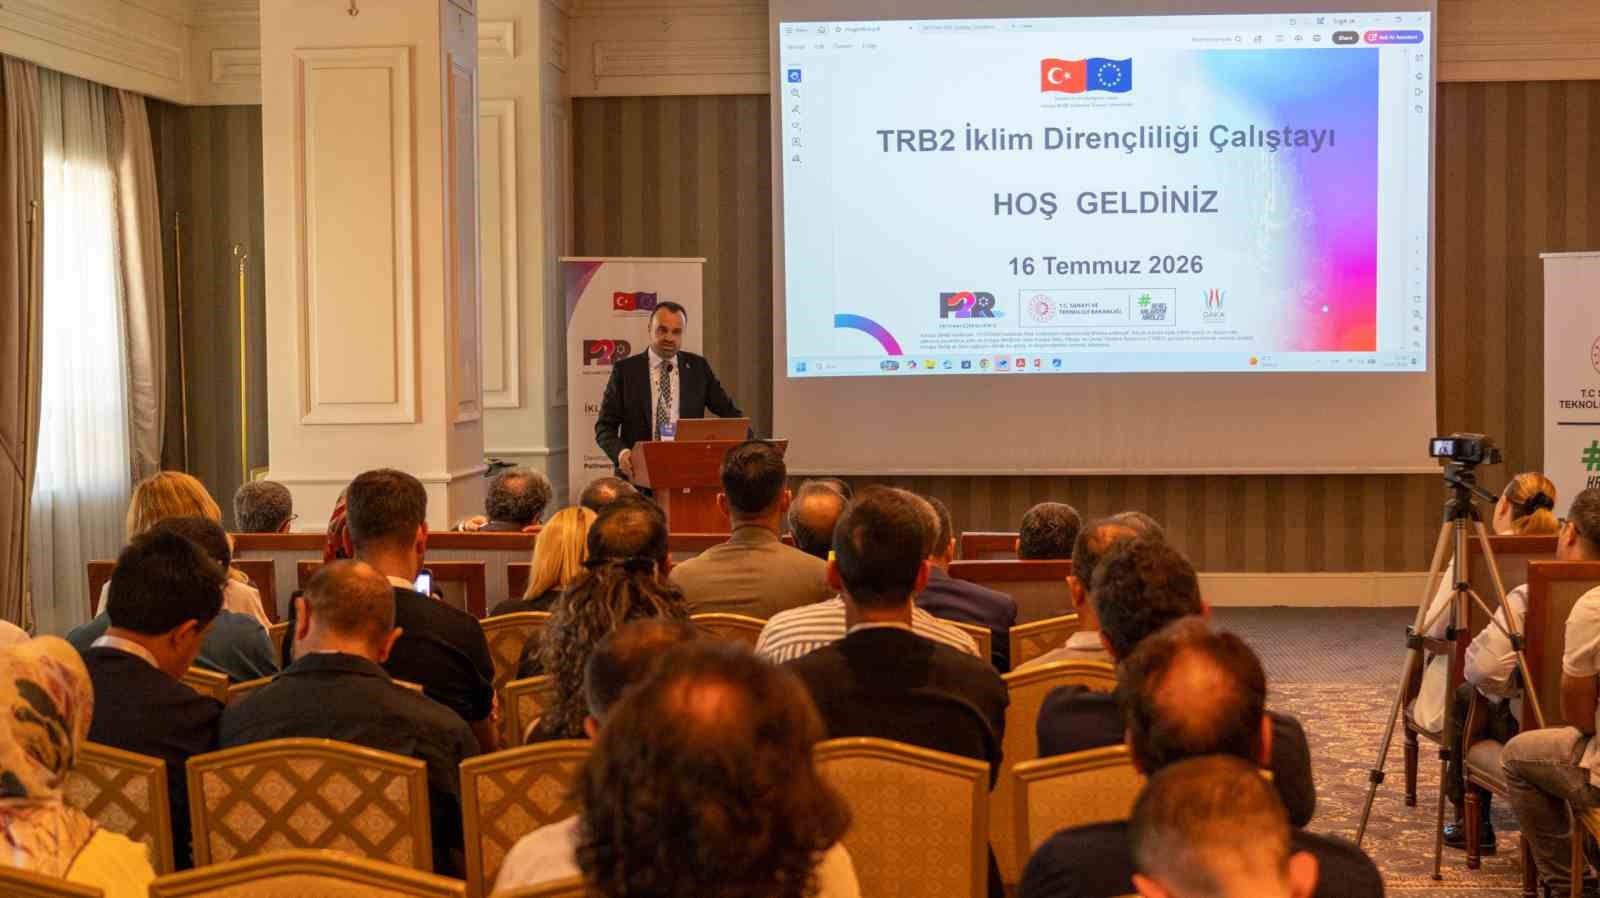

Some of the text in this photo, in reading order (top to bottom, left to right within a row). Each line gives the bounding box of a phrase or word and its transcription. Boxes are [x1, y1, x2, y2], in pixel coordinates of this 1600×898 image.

[876, 122, 1336, 155] TRB2 İklim Dirençliliği Çalıştayı
[993, 185, 1219, 221] HOŞ GELDİNİZ
[1008, 255, 1204, 276] 16 Temmuz 2026
[1559, 400, 1600, 409] TEKNOL
